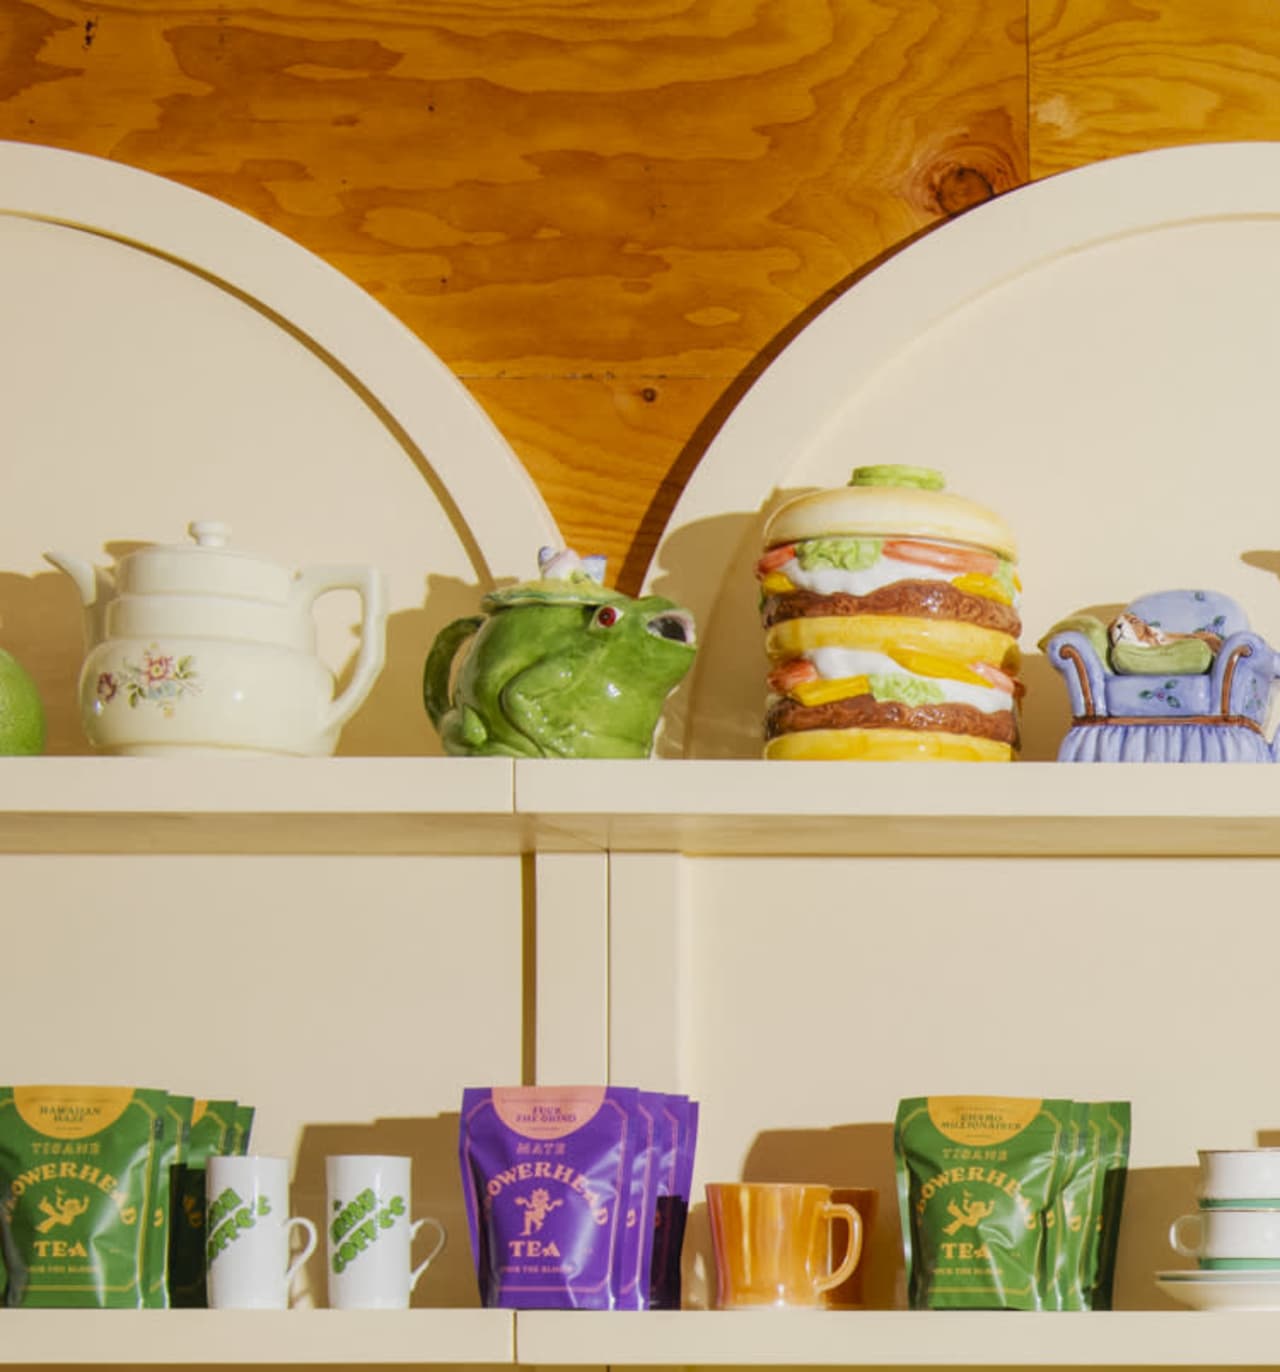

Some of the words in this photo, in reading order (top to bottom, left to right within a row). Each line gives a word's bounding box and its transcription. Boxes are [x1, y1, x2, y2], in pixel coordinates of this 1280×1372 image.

[33, 1240, 88, 1257] TEA
[508, 1241, 560, 1257] TEA
[941, 1243, 992, 1259] TEA
